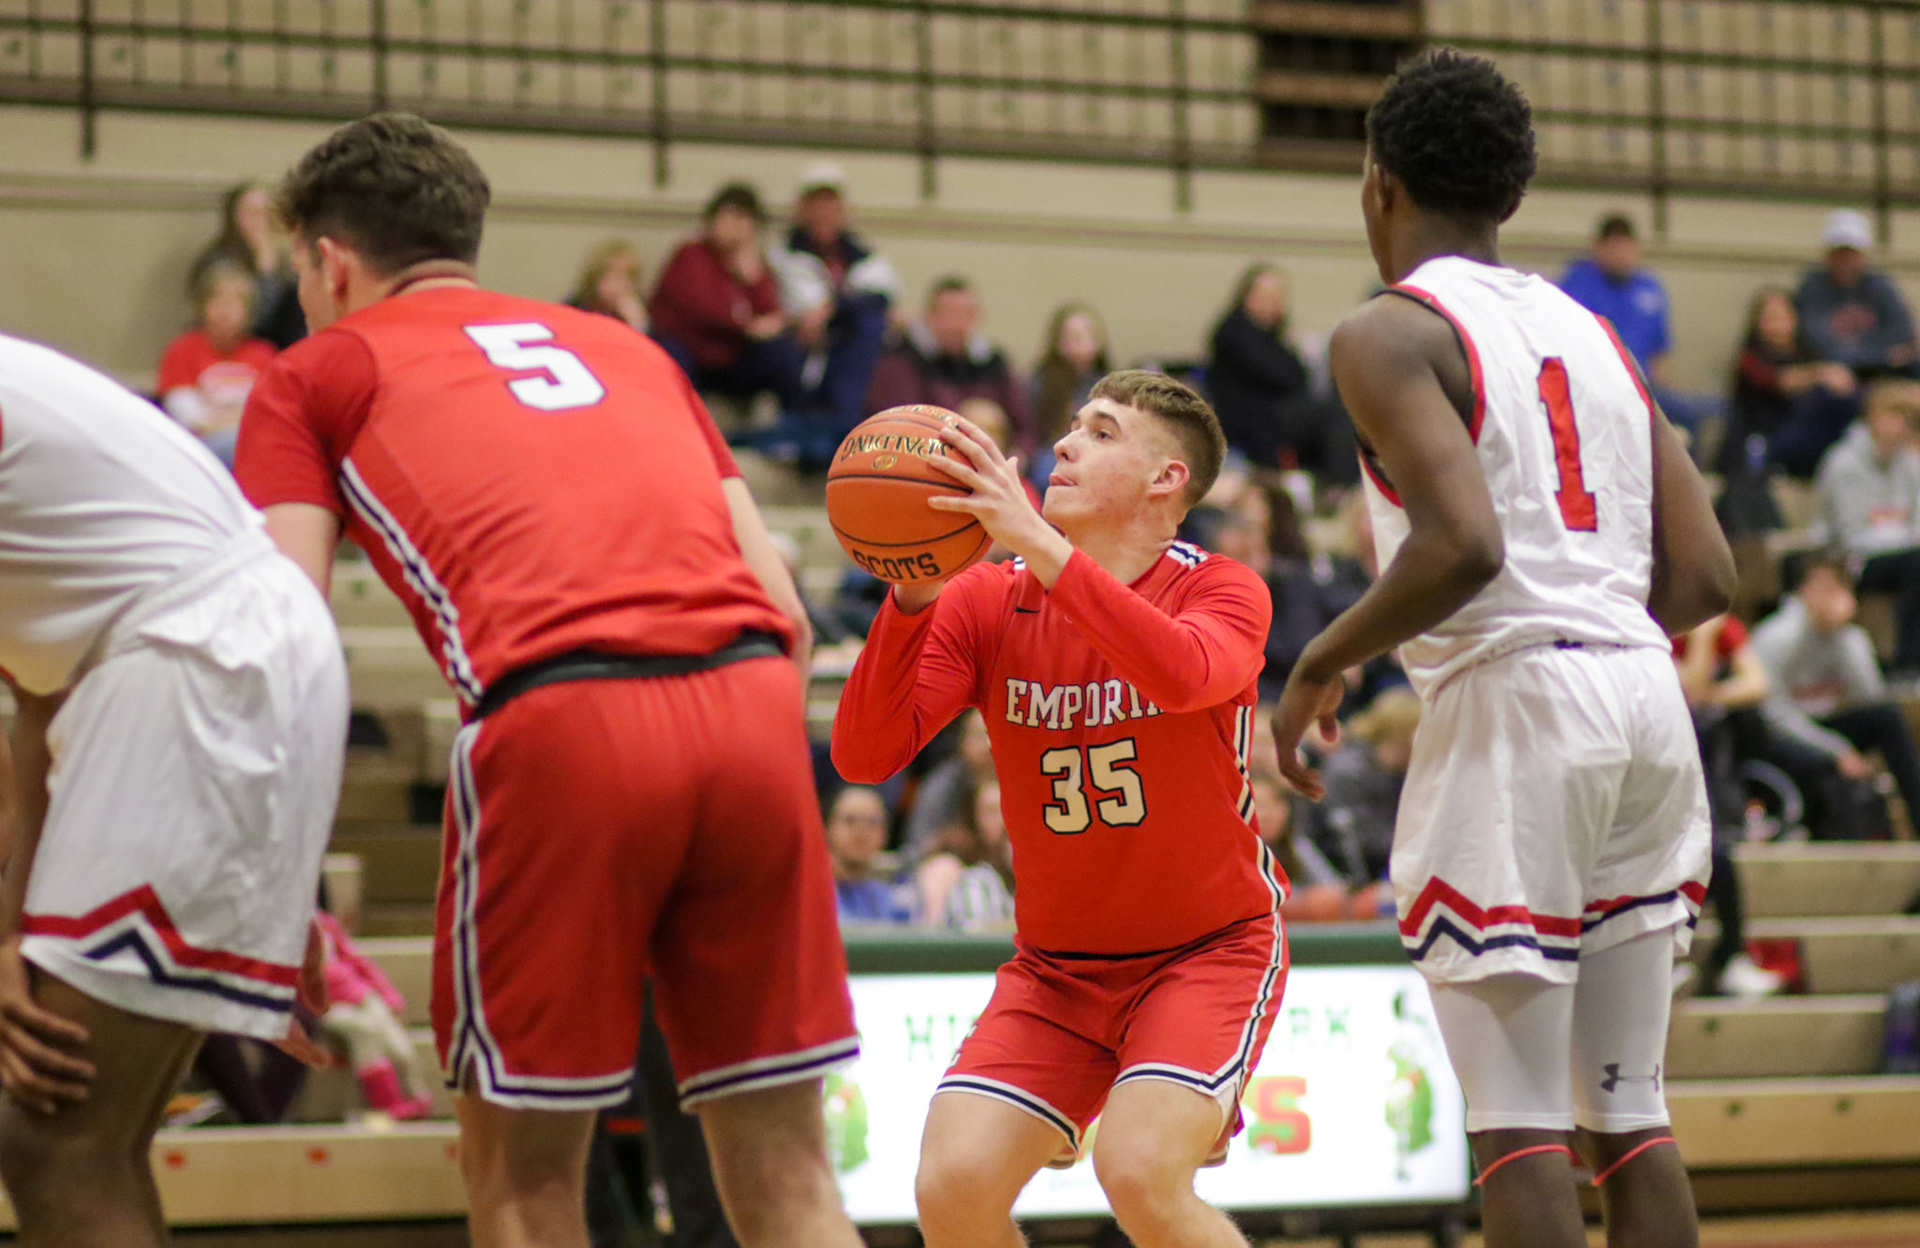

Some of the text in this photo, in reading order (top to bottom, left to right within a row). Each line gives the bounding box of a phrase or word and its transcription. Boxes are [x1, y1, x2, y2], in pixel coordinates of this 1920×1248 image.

[463, 321, 608, 411] 5
[1536, 356, 1598, 532] 1
[852, 548, 941, 580] SCOTS
[1040, 736, 1148, 835] 35
